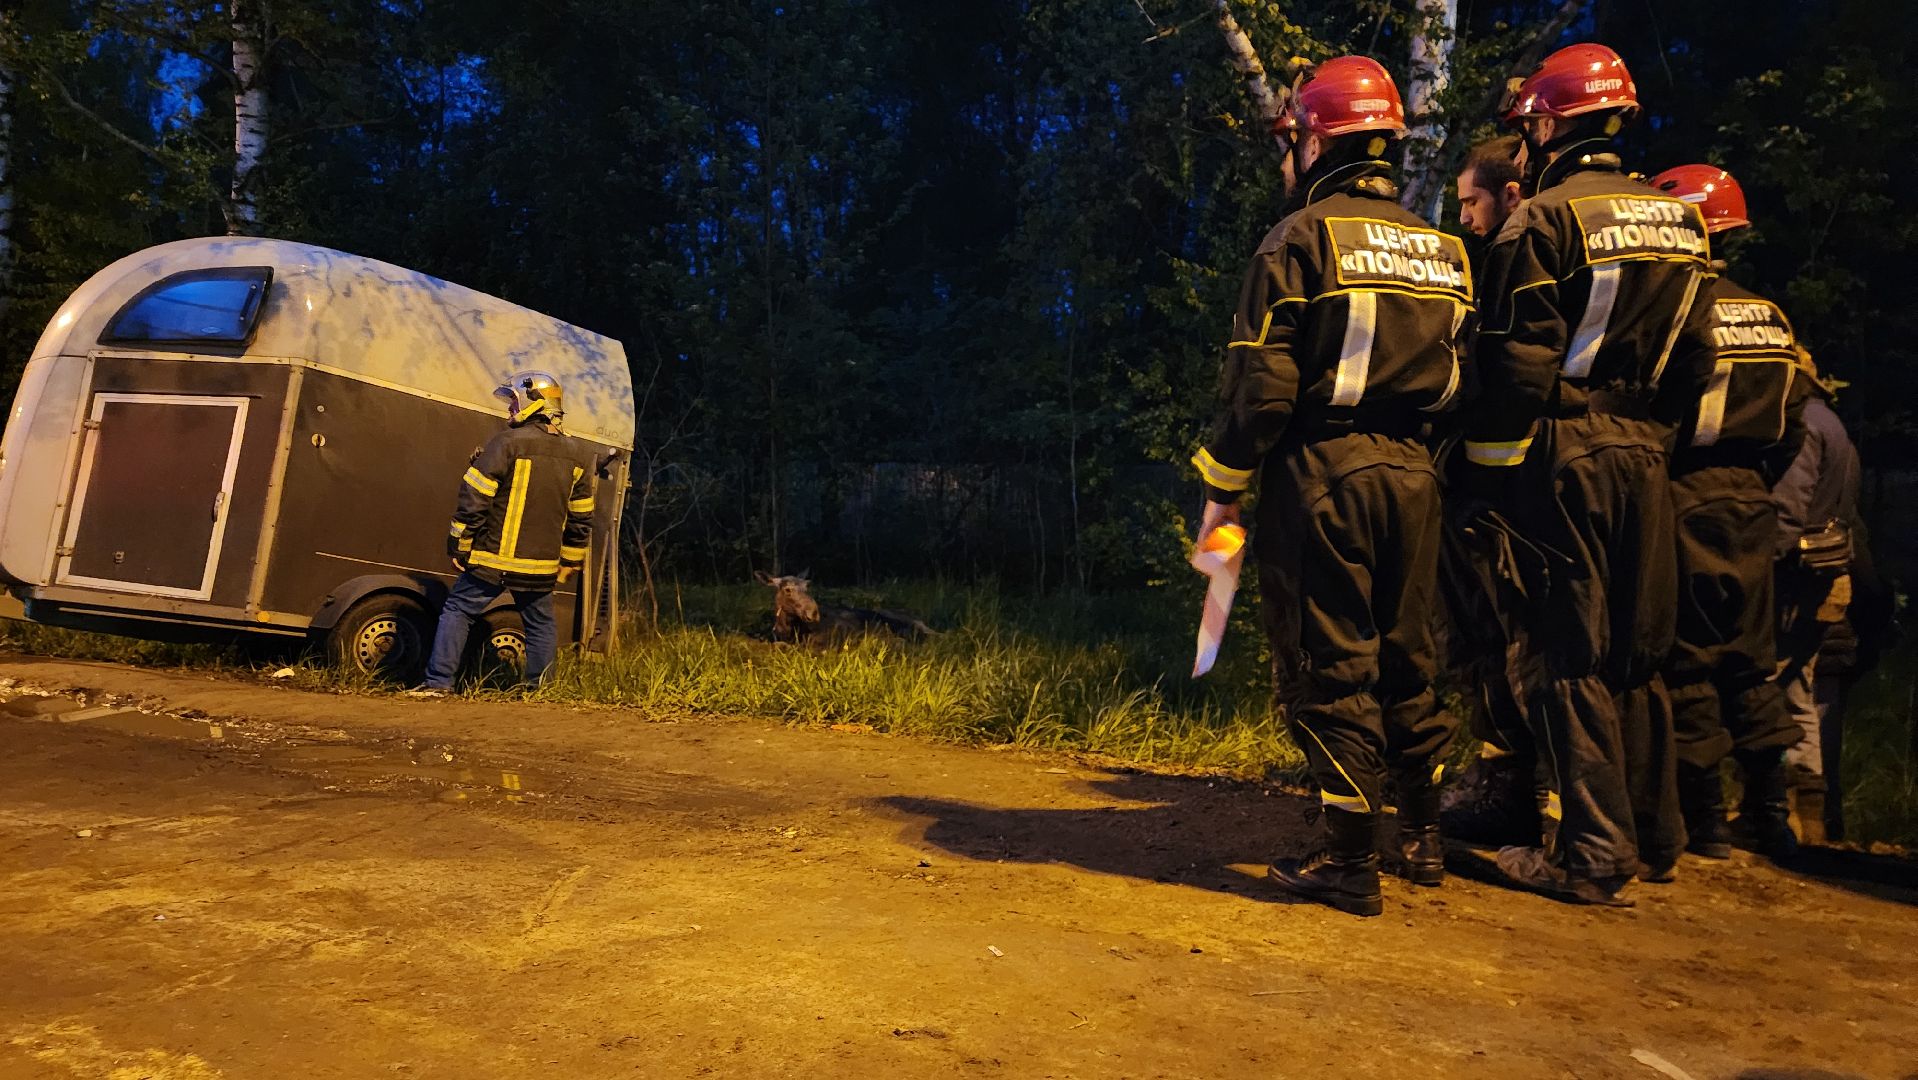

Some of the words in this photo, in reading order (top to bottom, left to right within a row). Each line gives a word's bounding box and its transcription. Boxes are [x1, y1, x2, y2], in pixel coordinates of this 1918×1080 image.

[1584, 78, 1623, 93] ЦЕНТР
[1610, 198, 1685, 223] ЦЕНТР
[1364, 222, 1442, 255] ЦЕНТР
[1714, 303, 1771, 325] ЦЕНТР
